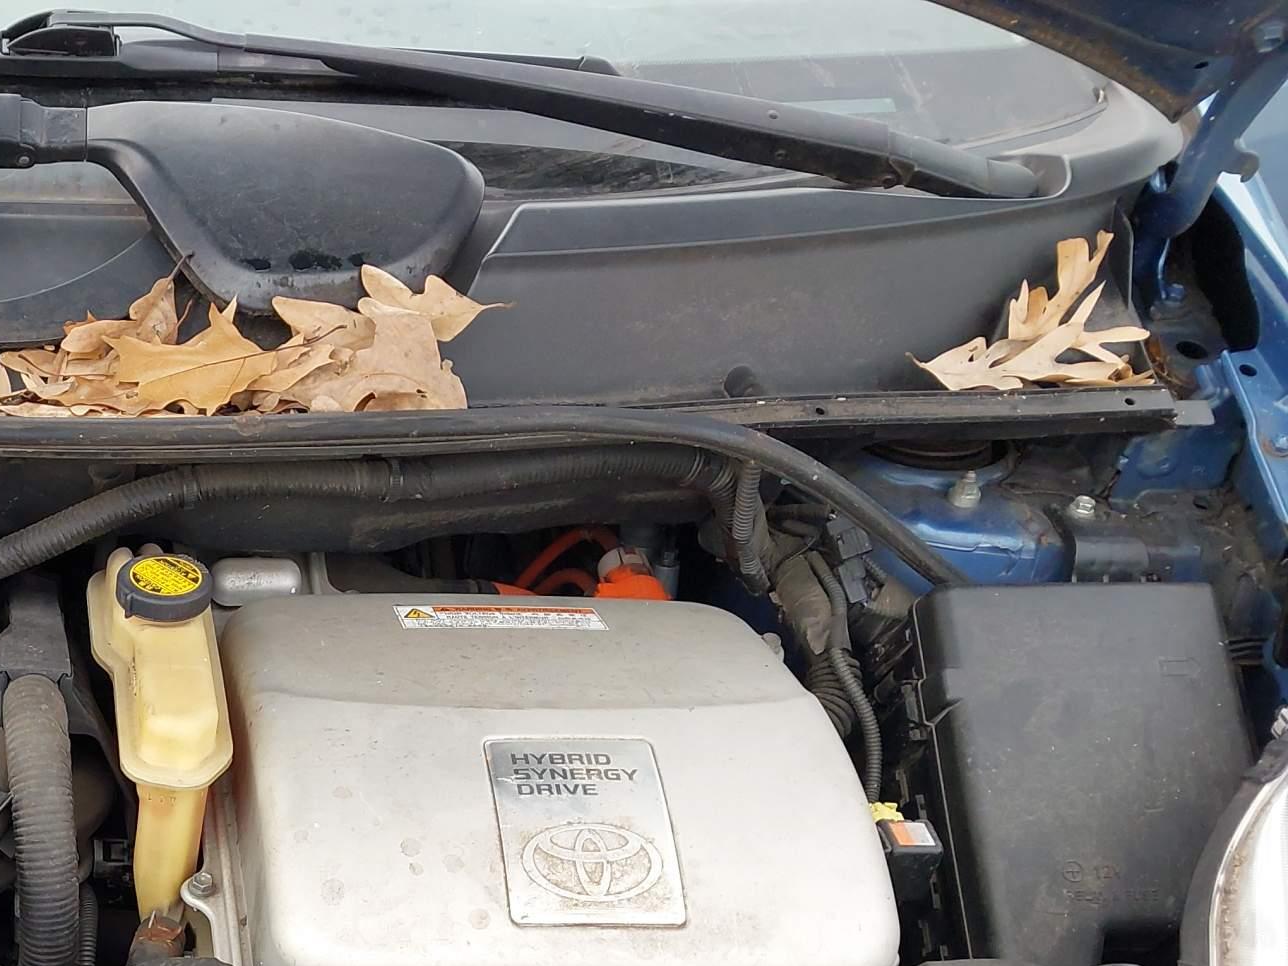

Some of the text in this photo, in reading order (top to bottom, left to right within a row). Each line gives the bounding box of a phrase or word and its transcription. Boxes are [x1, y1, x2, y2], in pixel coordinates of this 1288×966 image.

[510, 753, 612, 766] HYBRID
[513, 768, 638, 781] SYNERGY
[516, 783, 599, 796] DRIVE
